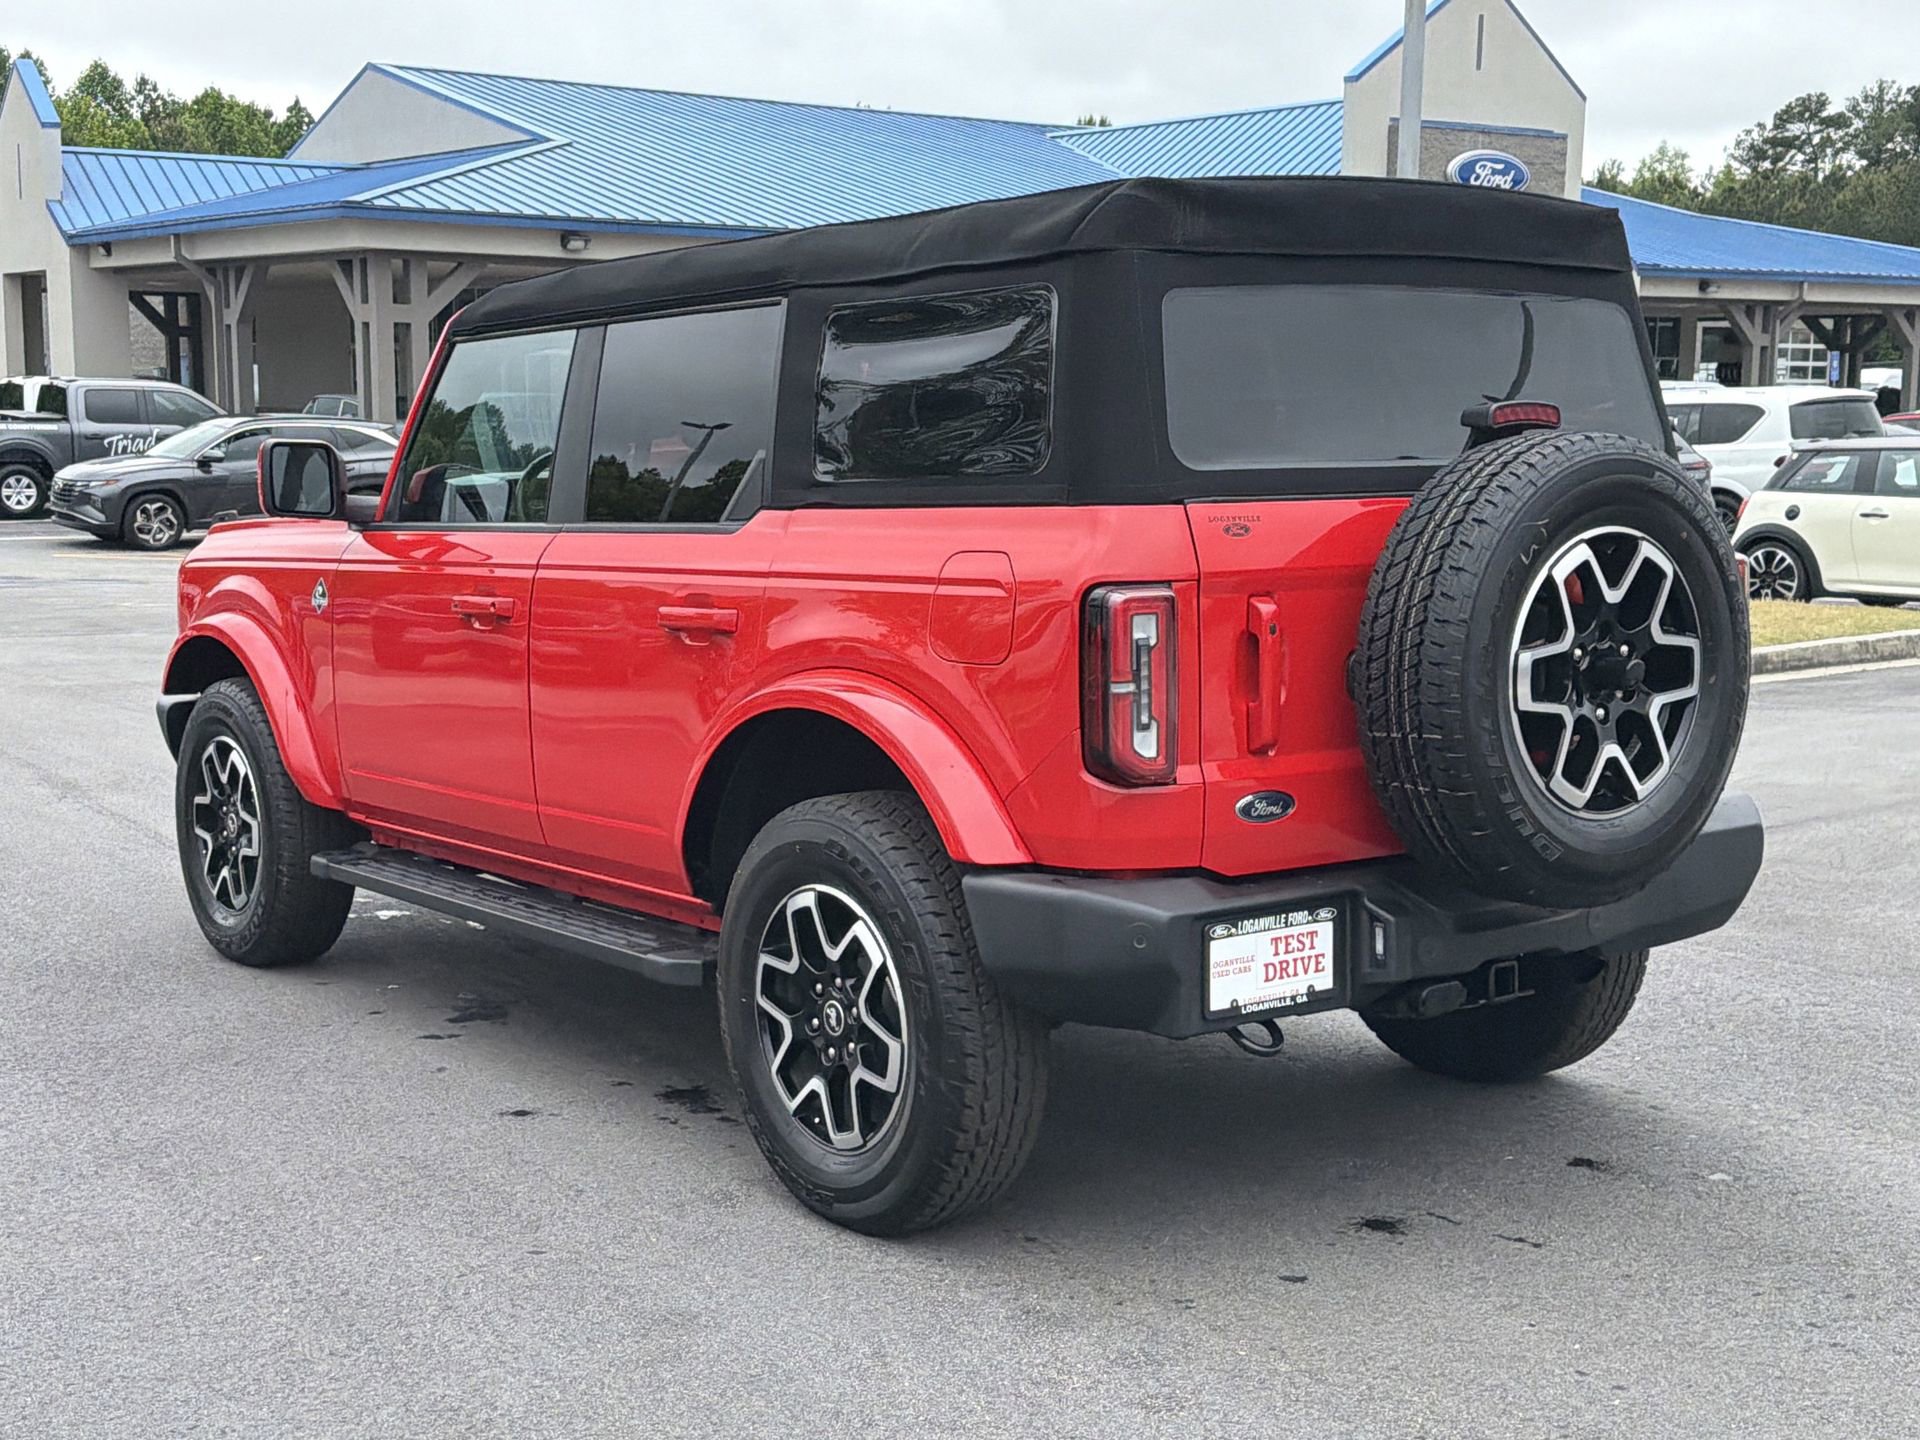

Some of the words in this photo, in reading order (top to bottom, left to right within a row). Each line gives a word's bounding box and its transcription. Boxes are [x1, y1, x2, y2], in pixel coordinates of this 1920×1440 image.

[1470, 161, 1515, 189] Ford
[104, 428, 160, 456] Triad
[1207, 515, 1261, 523] LOGANVILLE
[1251, 799, 1283, 817] Ford
[1238, 914, 1286, 935] LOGANVILLE
[1287, 910, 1309, 926] FORD
[1271, 930, 1318, 957] TEST
[1212, 969, 1230, 979] USED
[1232, 965, 1252, 976] CARS
[1213, 955, 1256, 969] OGANVILLE
[1263, 953, 1326, 983] DRIVE
[1241, 997, 1295, 1014] LOGANVILLE,
[1296, 994, 1309, 1004] GA
